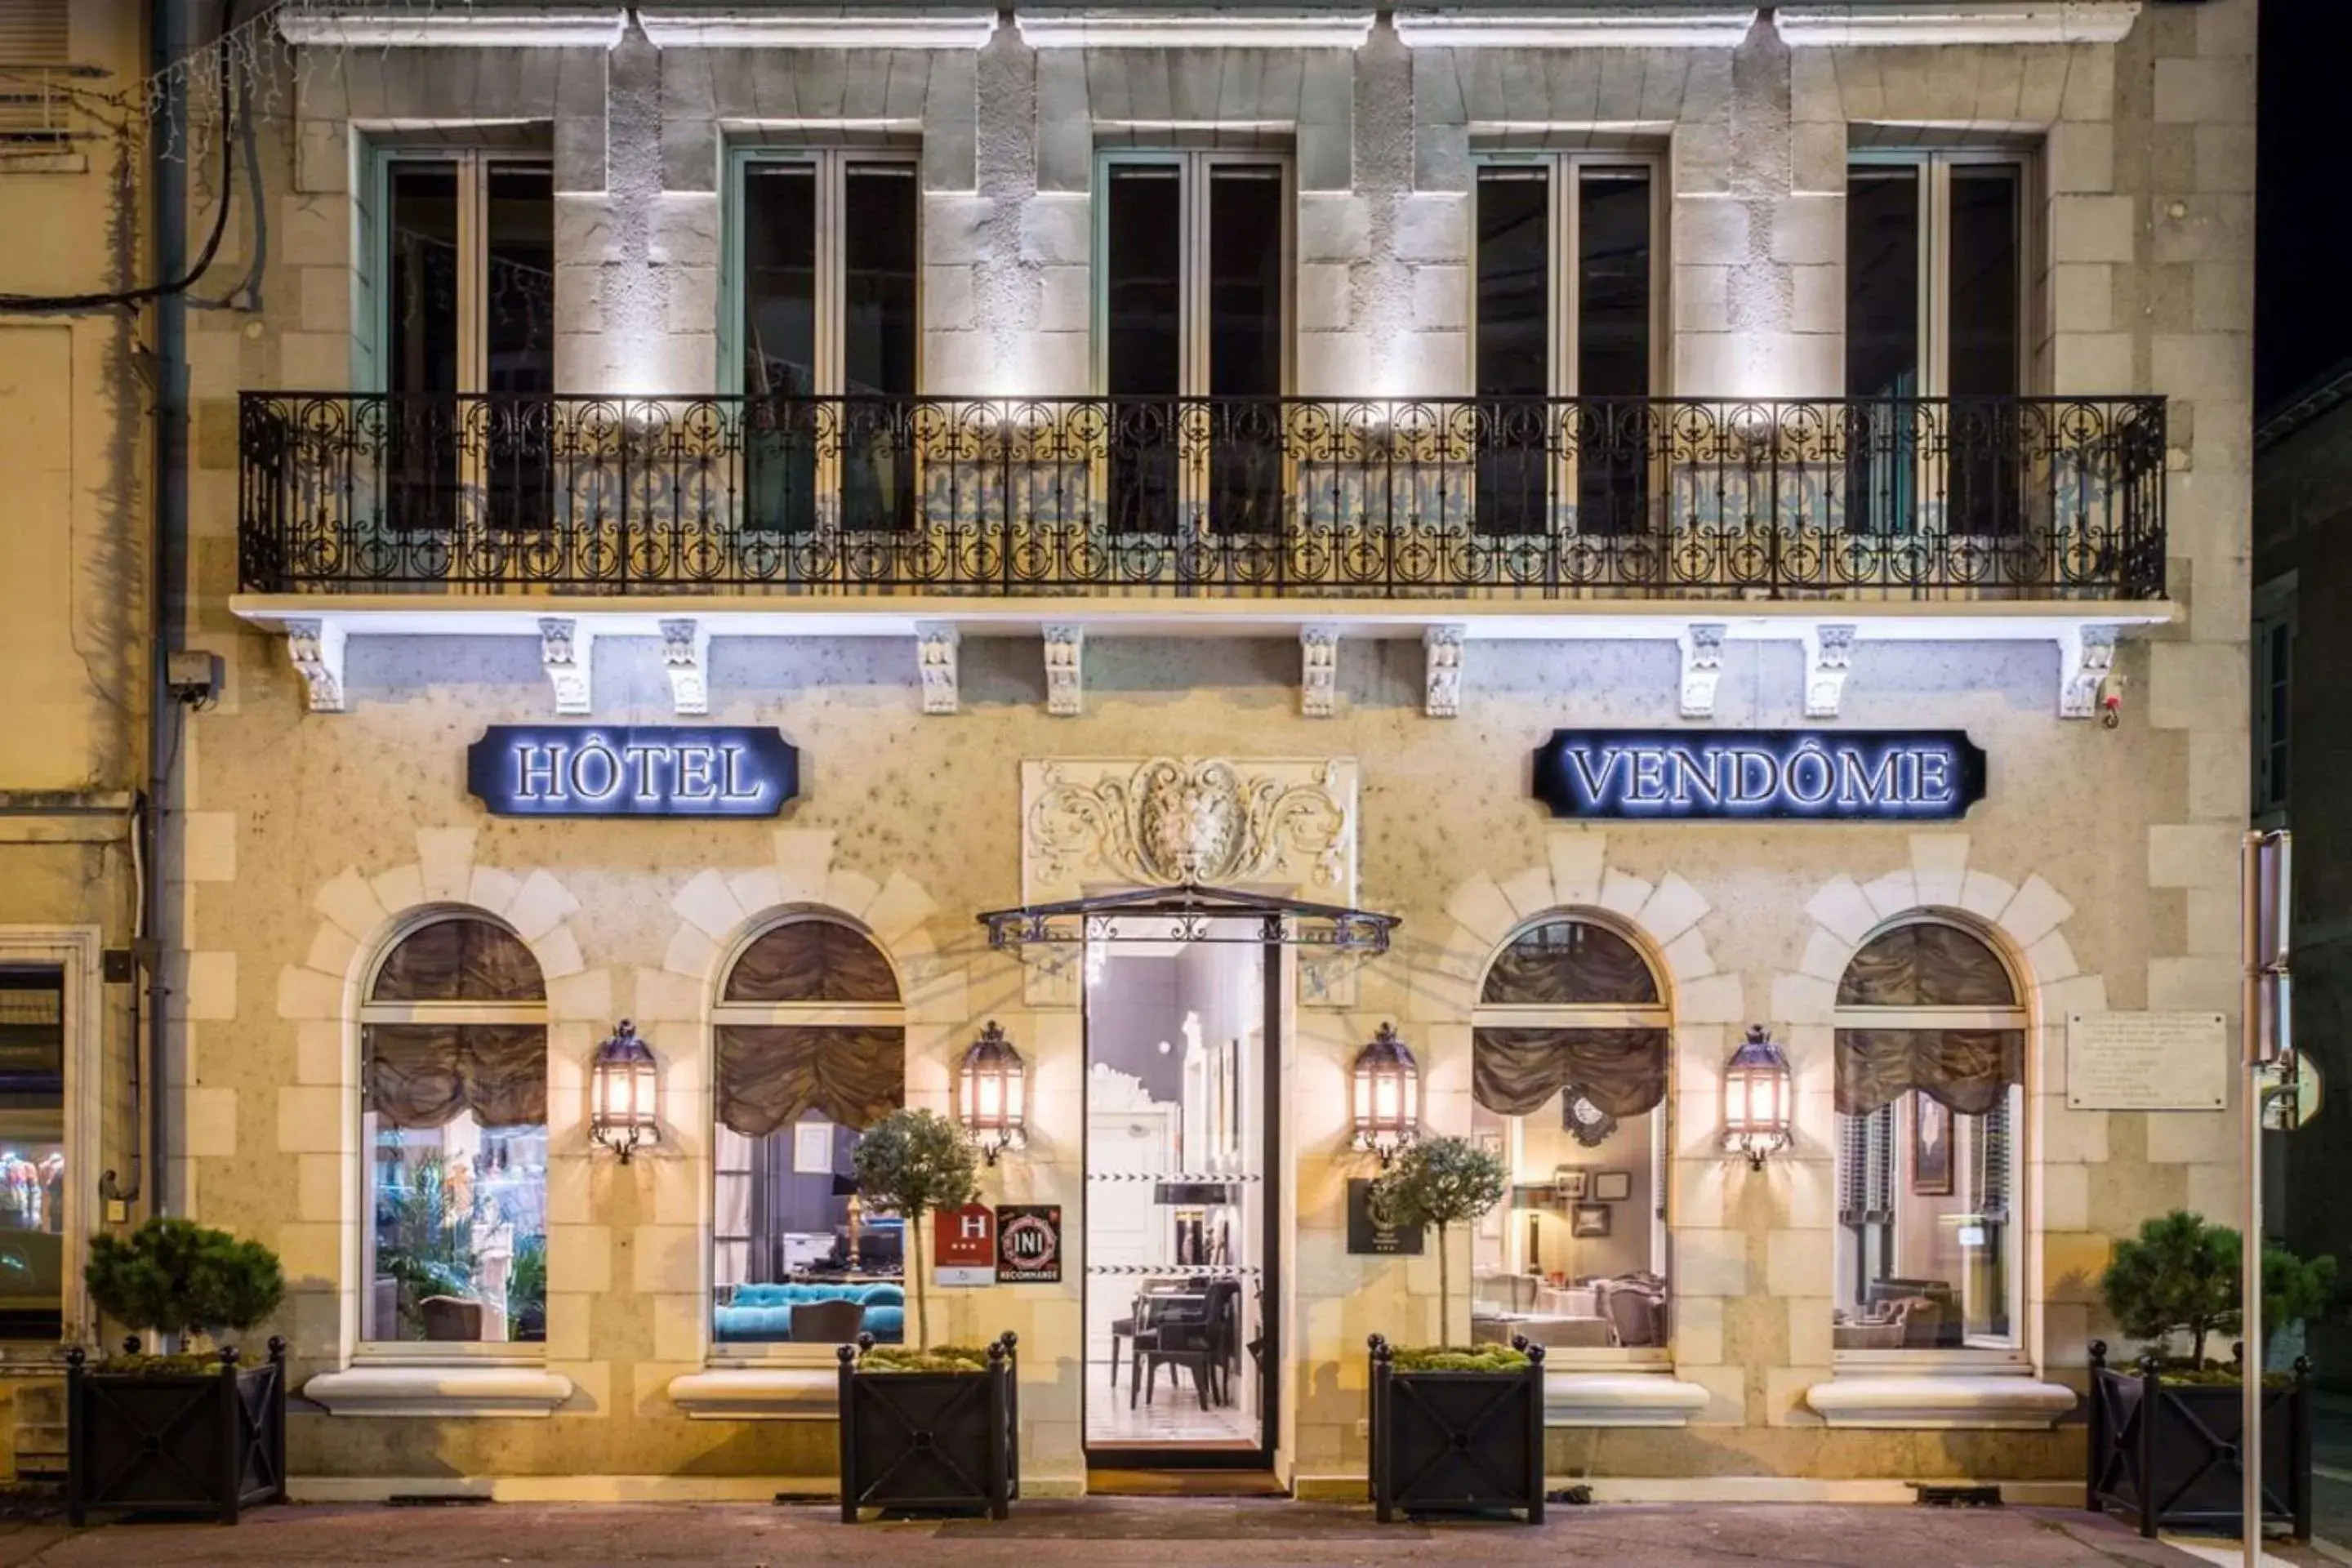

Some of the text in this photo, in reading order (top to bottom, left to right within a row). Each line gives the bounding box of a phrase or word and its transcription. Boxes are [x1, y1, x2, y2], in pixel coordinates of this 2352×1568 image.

[515, 733, 764, 800] HÔTEL
[1568, 738, 1953, 804] VENDÔME
[961, 1214, 987, 1238] H
